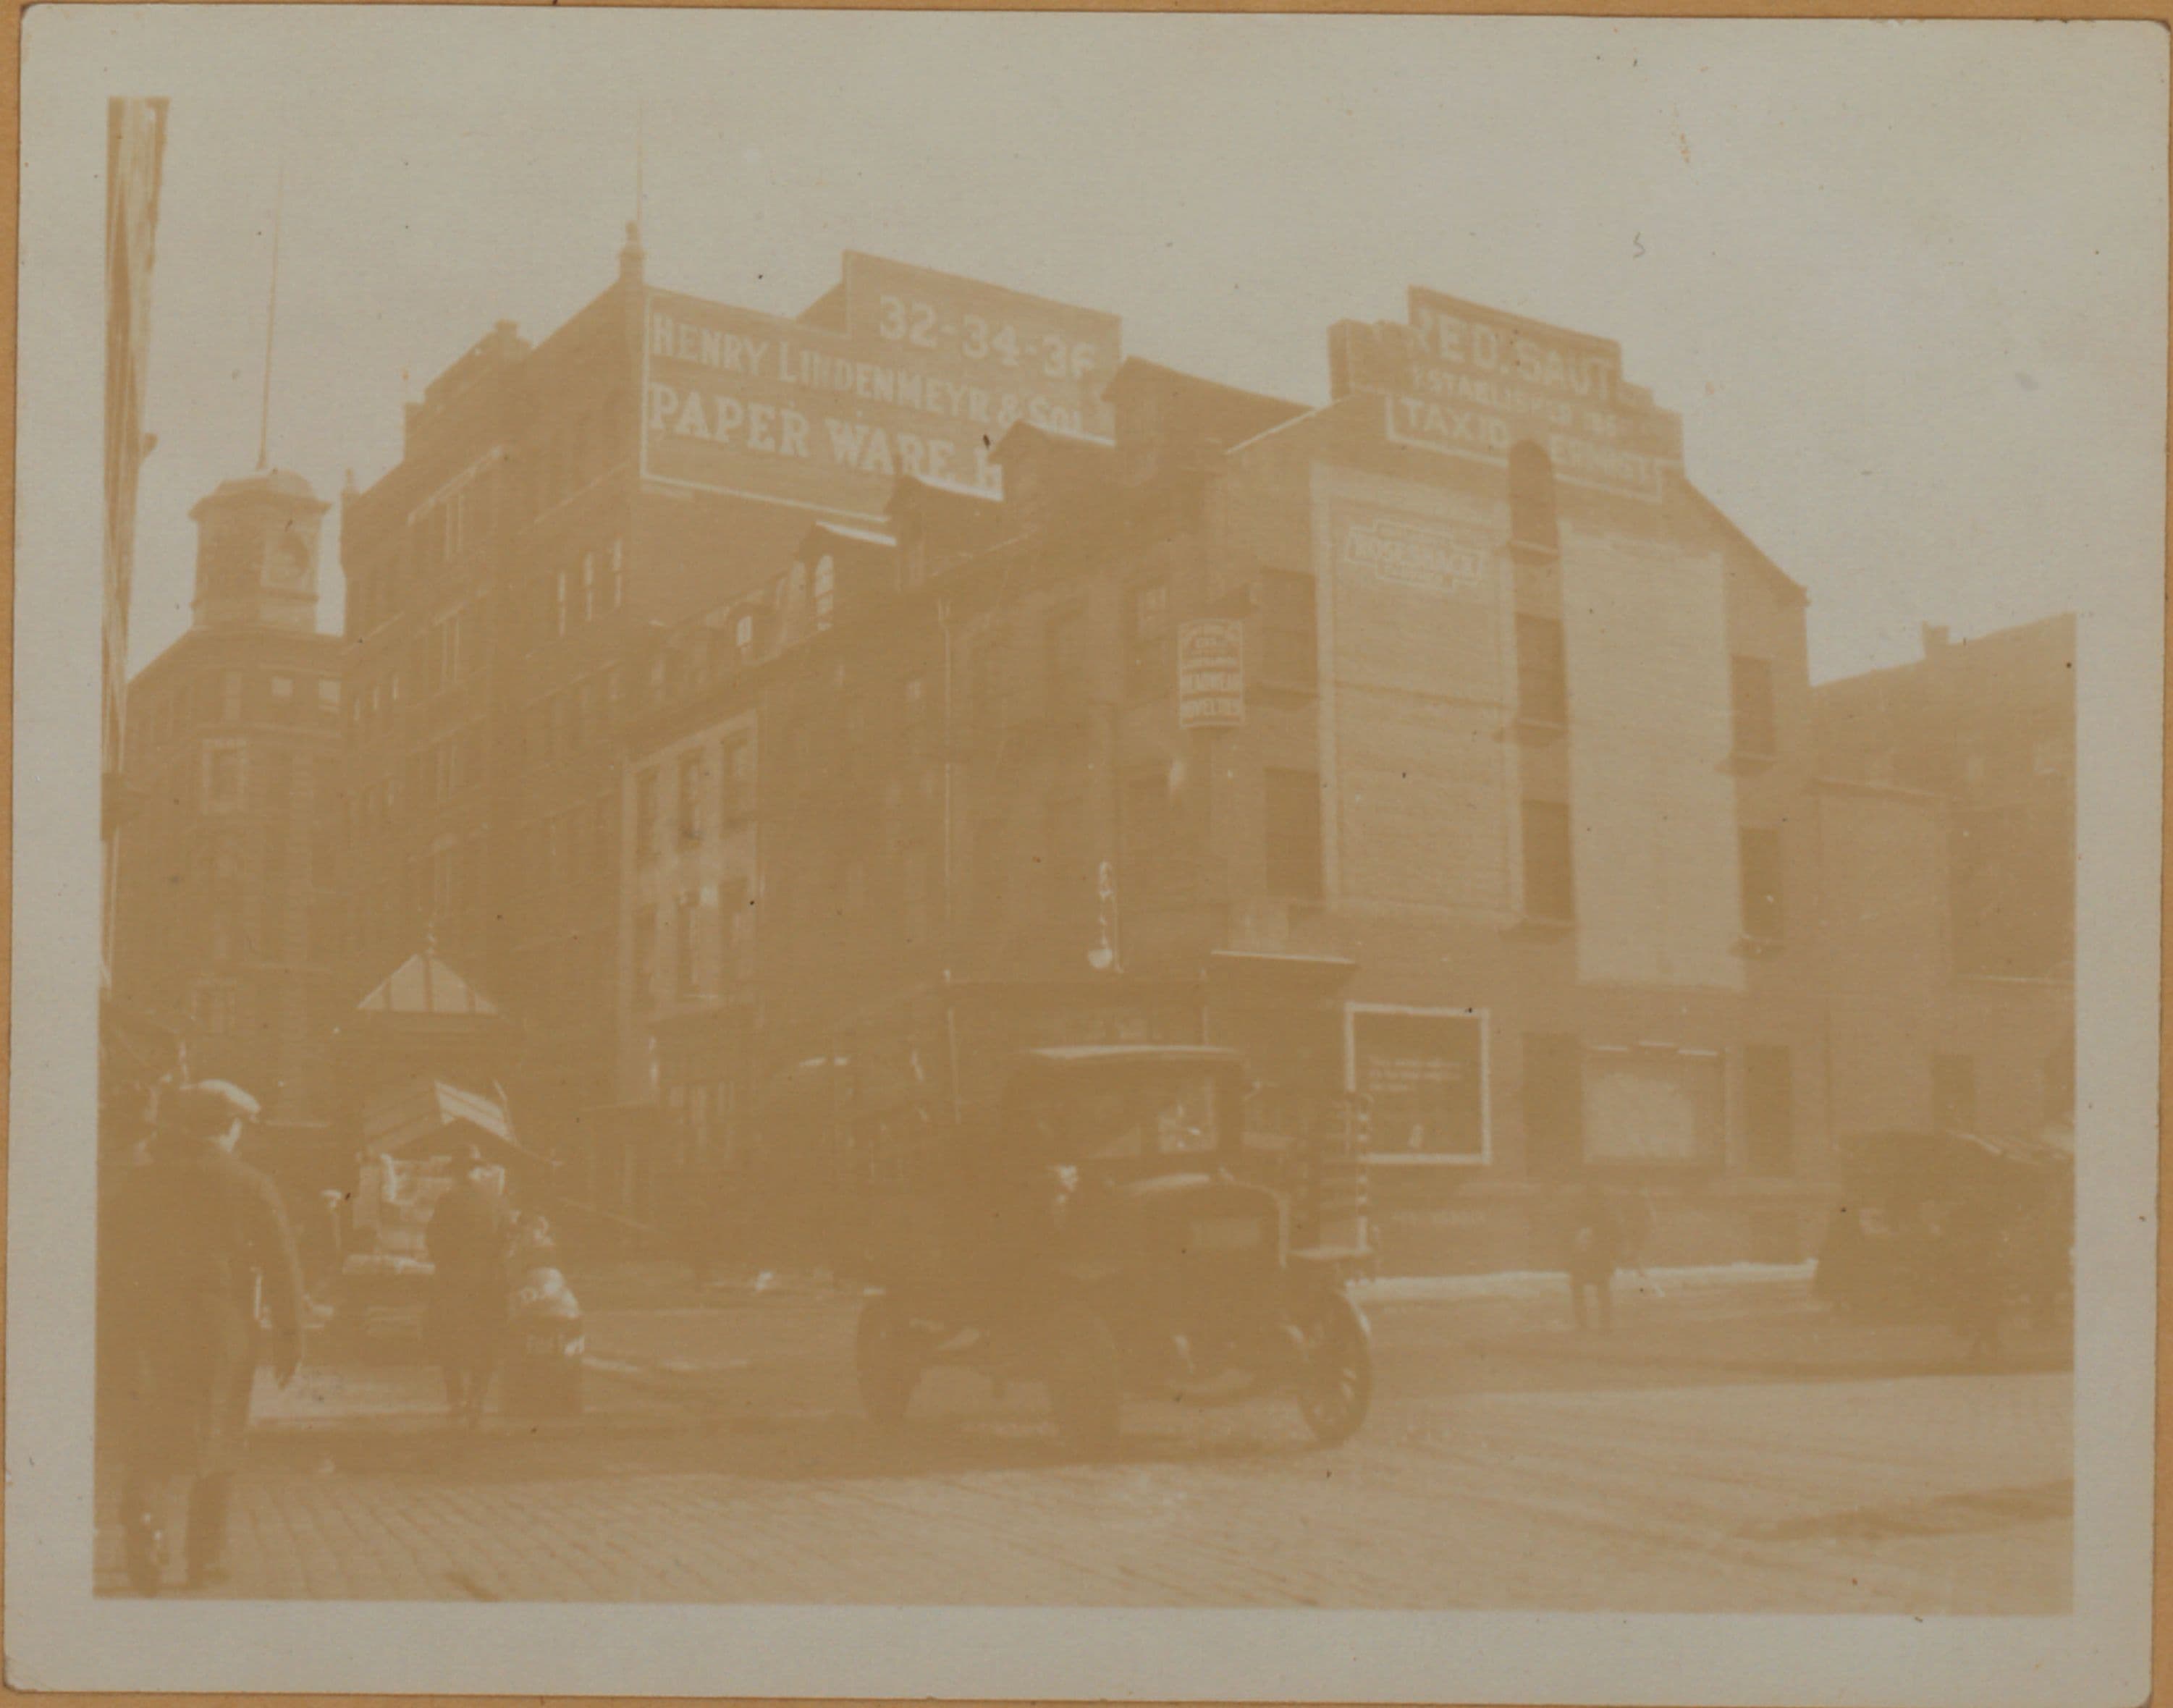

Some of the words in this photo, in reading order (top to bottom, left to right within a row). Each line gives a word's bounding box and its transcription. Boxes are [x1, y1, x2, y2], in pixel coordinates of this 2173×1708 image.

[652, 312, 769, 377] HENRY
[777, 340, 990, 423] LINDENMEYR
[996, 392, 1025, 428] &
[649, 381, 811, 459] PAPER
